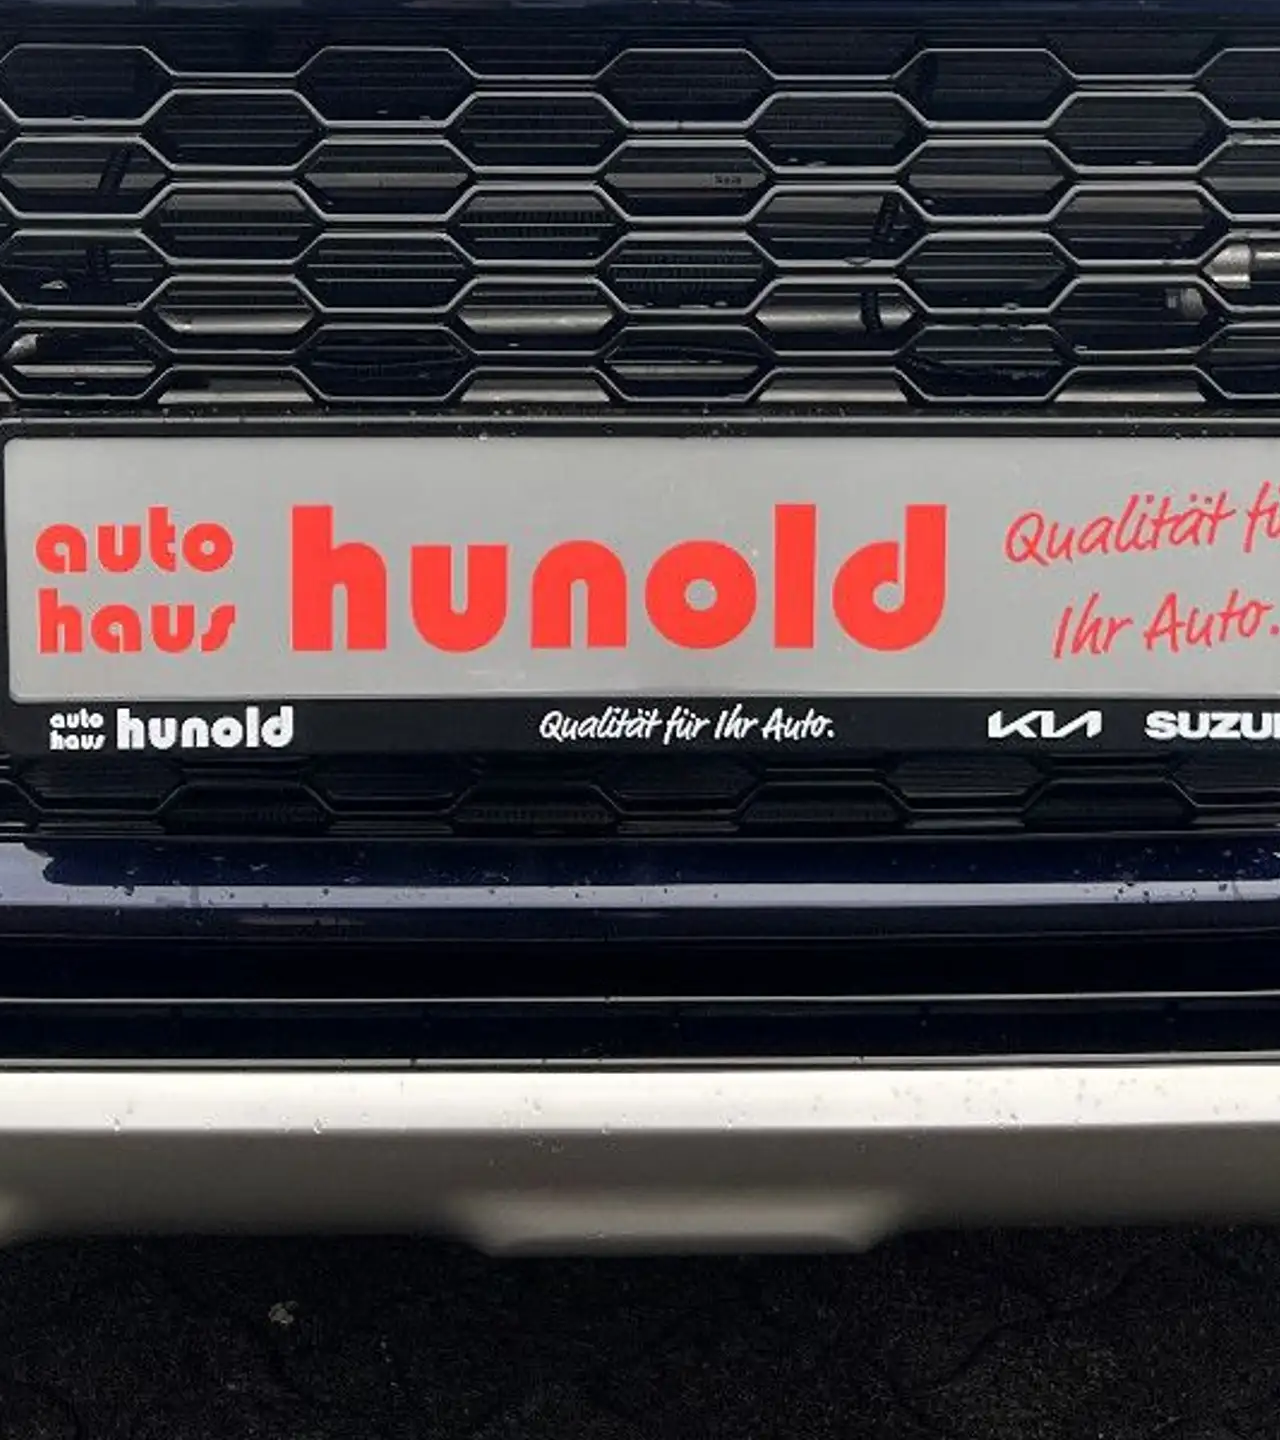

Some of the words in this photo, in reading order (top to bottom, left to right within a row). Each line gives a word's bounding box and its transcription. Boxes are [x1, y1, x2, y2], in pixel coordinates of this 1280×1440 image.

[35, 505, 234, 574] auto
[1003, 492, 1235, 566] Qualität
[290, 503, 948, 653] hunold
[37, 587, 236, 655] haus
[1053, 593, 1133, 659] Ihr
[1143, 589, 1280, 654] Auto.
[49, 707, 104, 729] auto
[49, 729, 106, 750] haus
[116, 705, 294, 750] hunold
[539, 705, 662, 742] Qualität
[663, 705, 710, 746] für
[714, 704, 758, 739] Ihr
[762, 707, 835, 742] Auto.
[987, 710, 1102, 738] KIA
